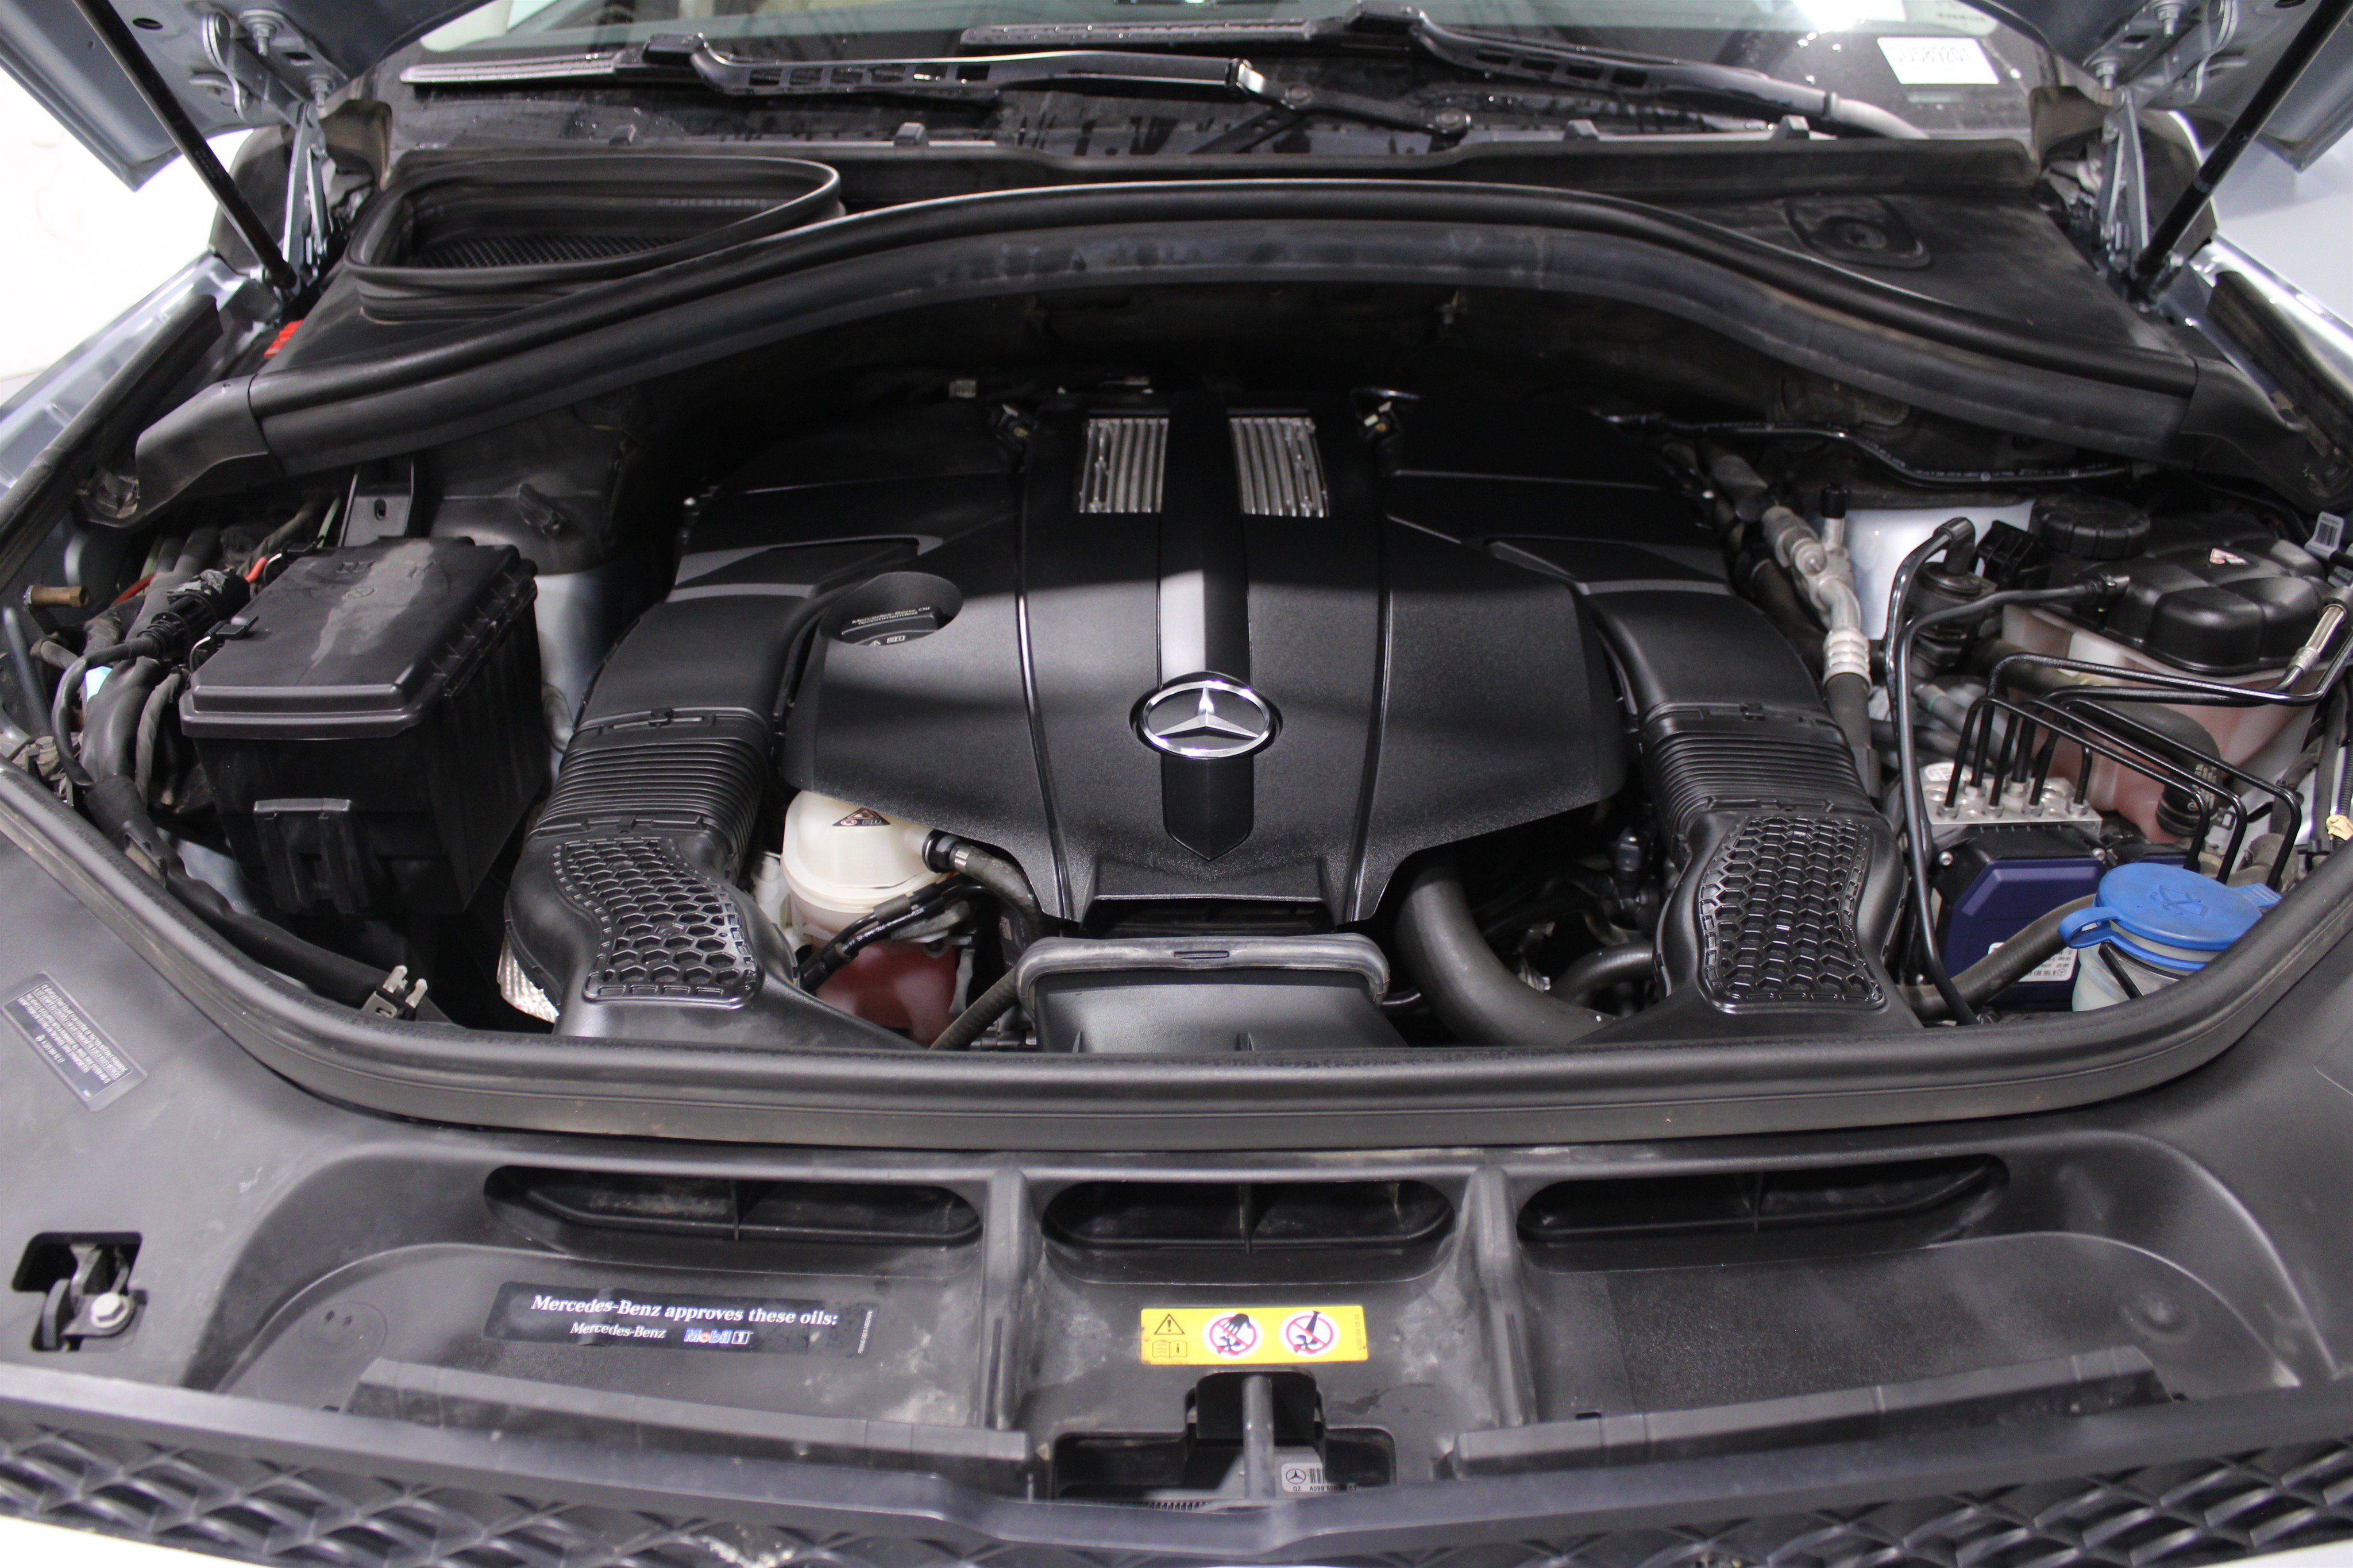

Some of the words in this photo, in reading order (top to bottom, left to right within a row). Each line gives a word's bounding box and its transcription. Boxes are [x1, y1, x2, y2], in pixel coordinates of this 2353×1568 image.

[851, 609, 916, 624] Mercedes-Benz
[858, 611, 917, 625] recommended
[531, 1295, 662, 1316] Mercedes-Benz
[665, 1306, 744, 1322] approves
[749, 1307, 795, 1323] these
[800, 1309, 838, 1325] oils:
[569, 1322, 667, 1339] Mercedes-Benz
[684, 1328, 732, 1343] Mobil
